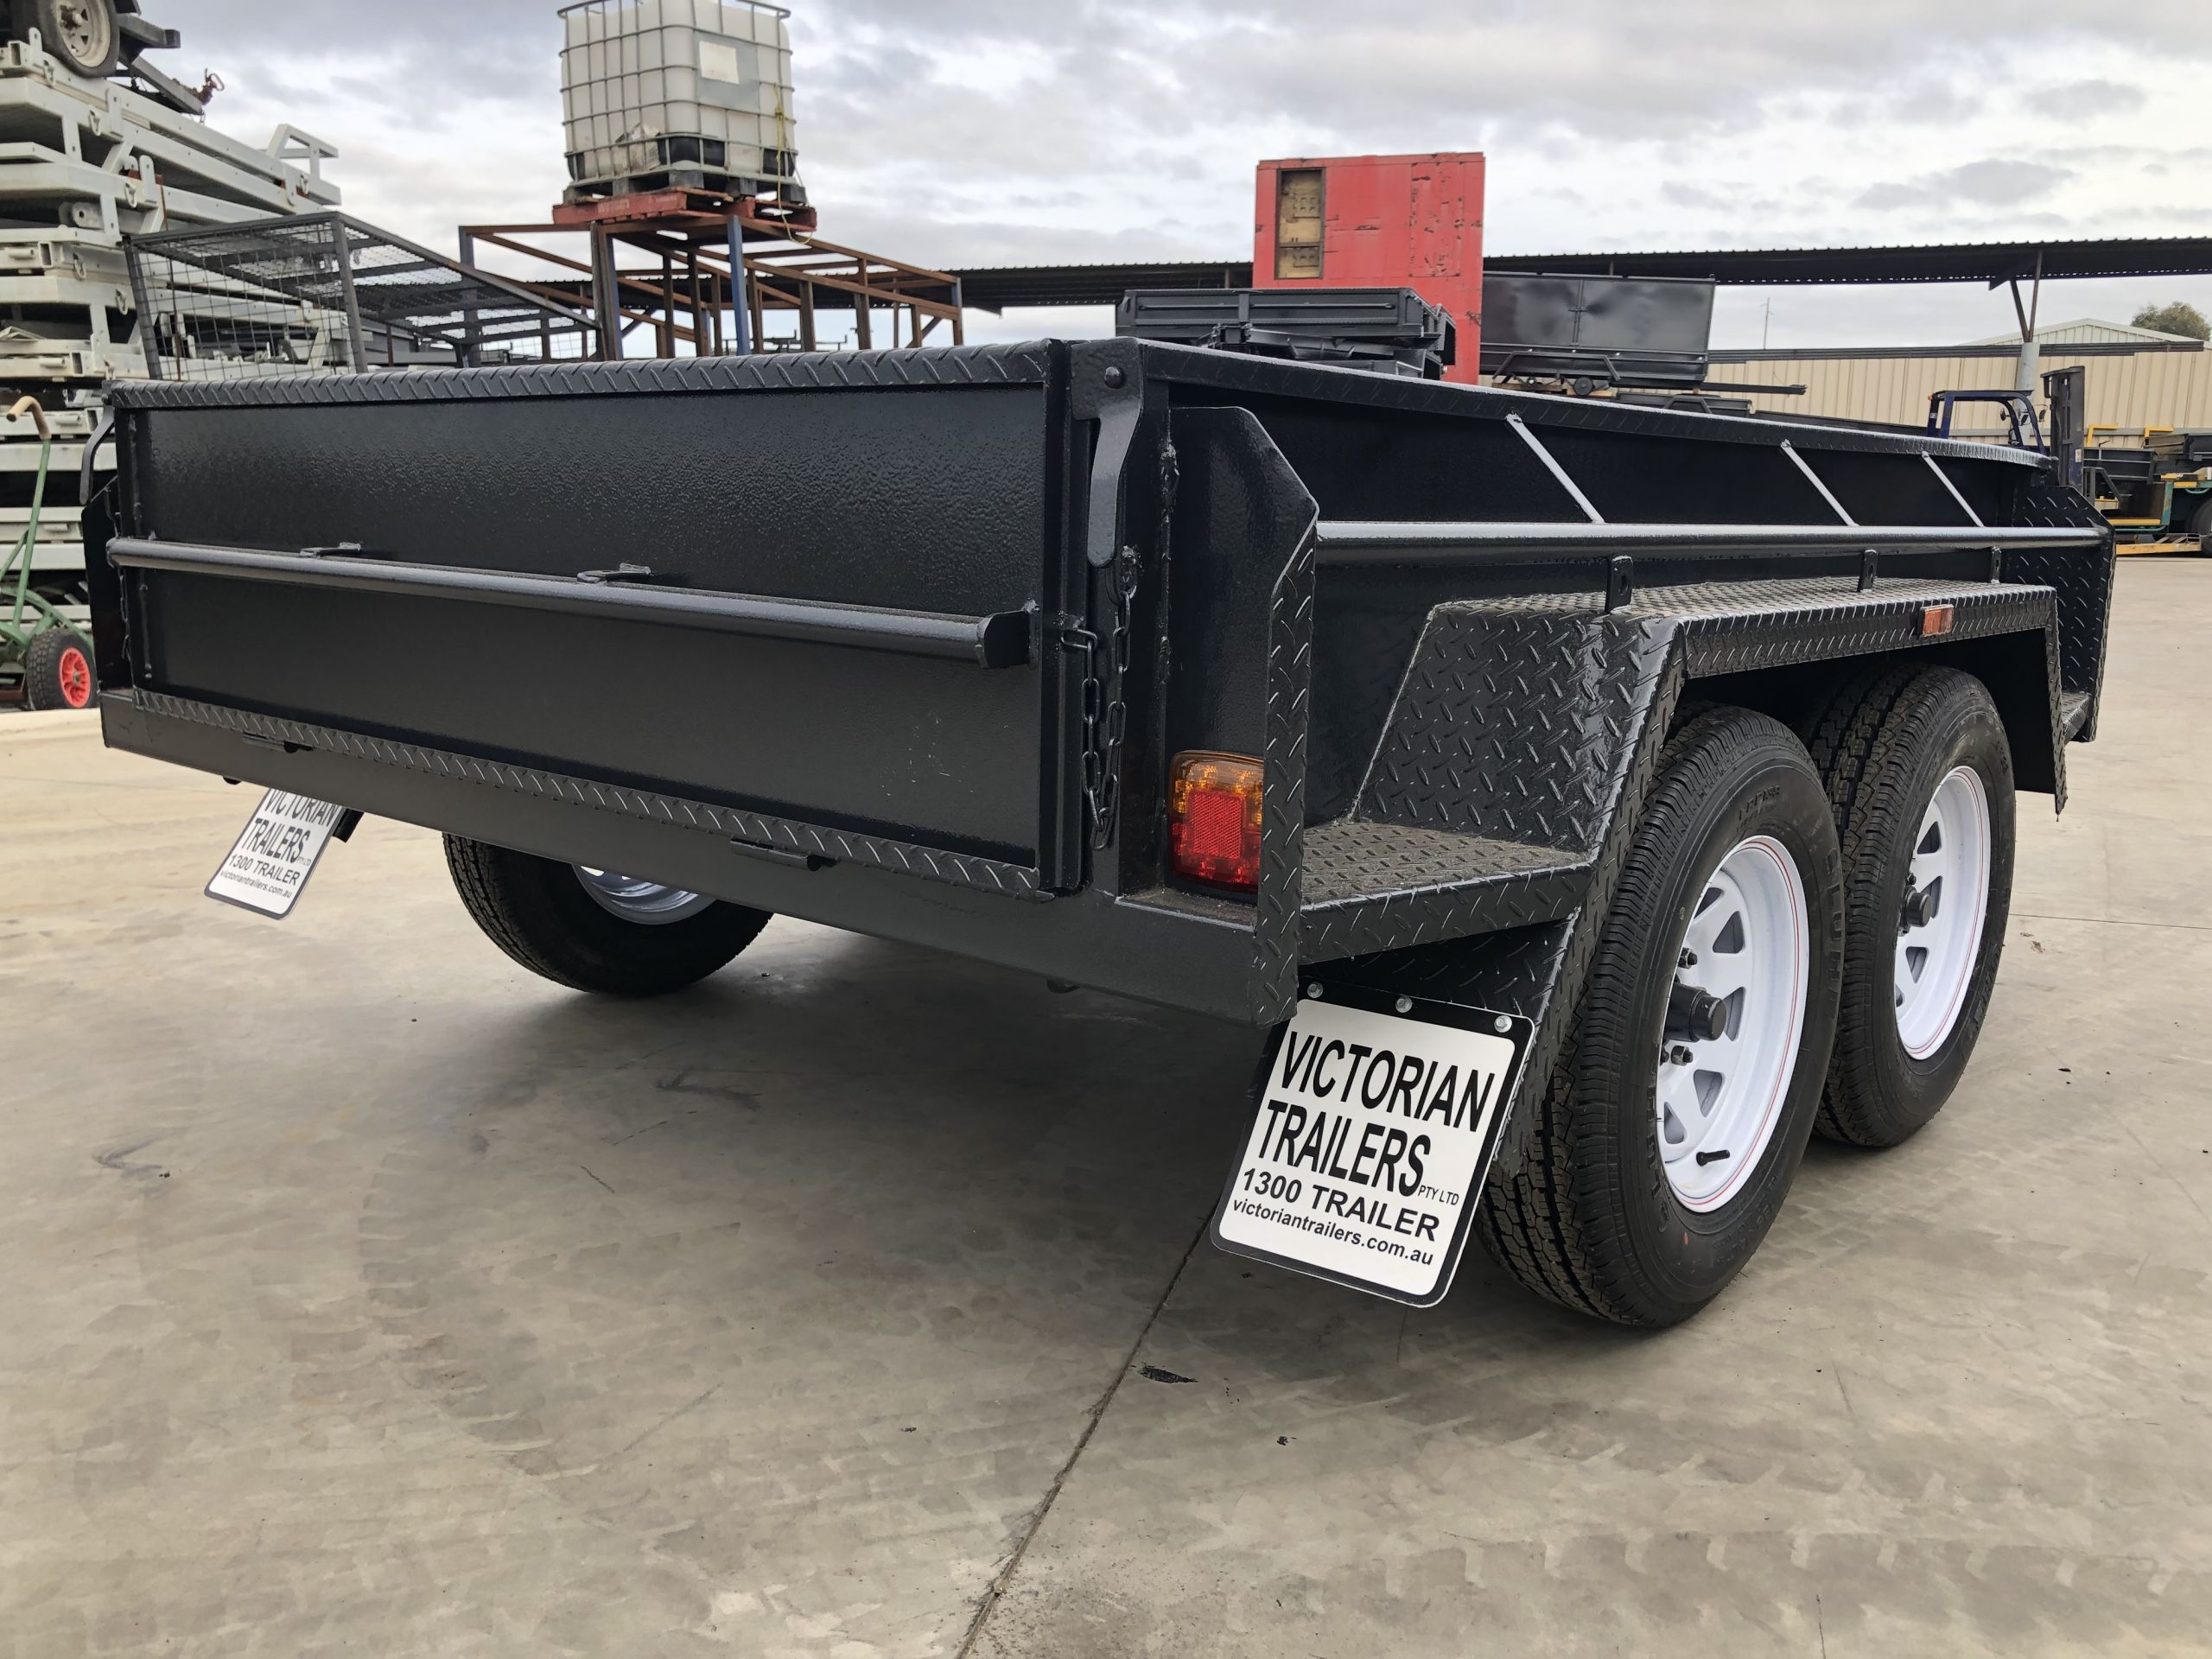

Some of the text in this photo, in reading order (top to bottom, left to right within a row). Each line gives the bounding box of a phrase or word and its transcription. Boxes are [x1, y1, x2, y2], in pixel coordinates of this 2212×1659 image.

[230, 854, 253, 871] 1300
[253, 860, 301, 886] TRAILER
[242, 818, 311, 863] TRAILERS
[1281, 1031, 1495, 1133] VICTORIAN
[1258, 1099, 1460, 1206] TRAILERS PTY LTD
[1232, 1198, 1434, 1267] victoriantrailers.com.au
[1243, 1167, 1440, 1243] 1300 TRAILER
